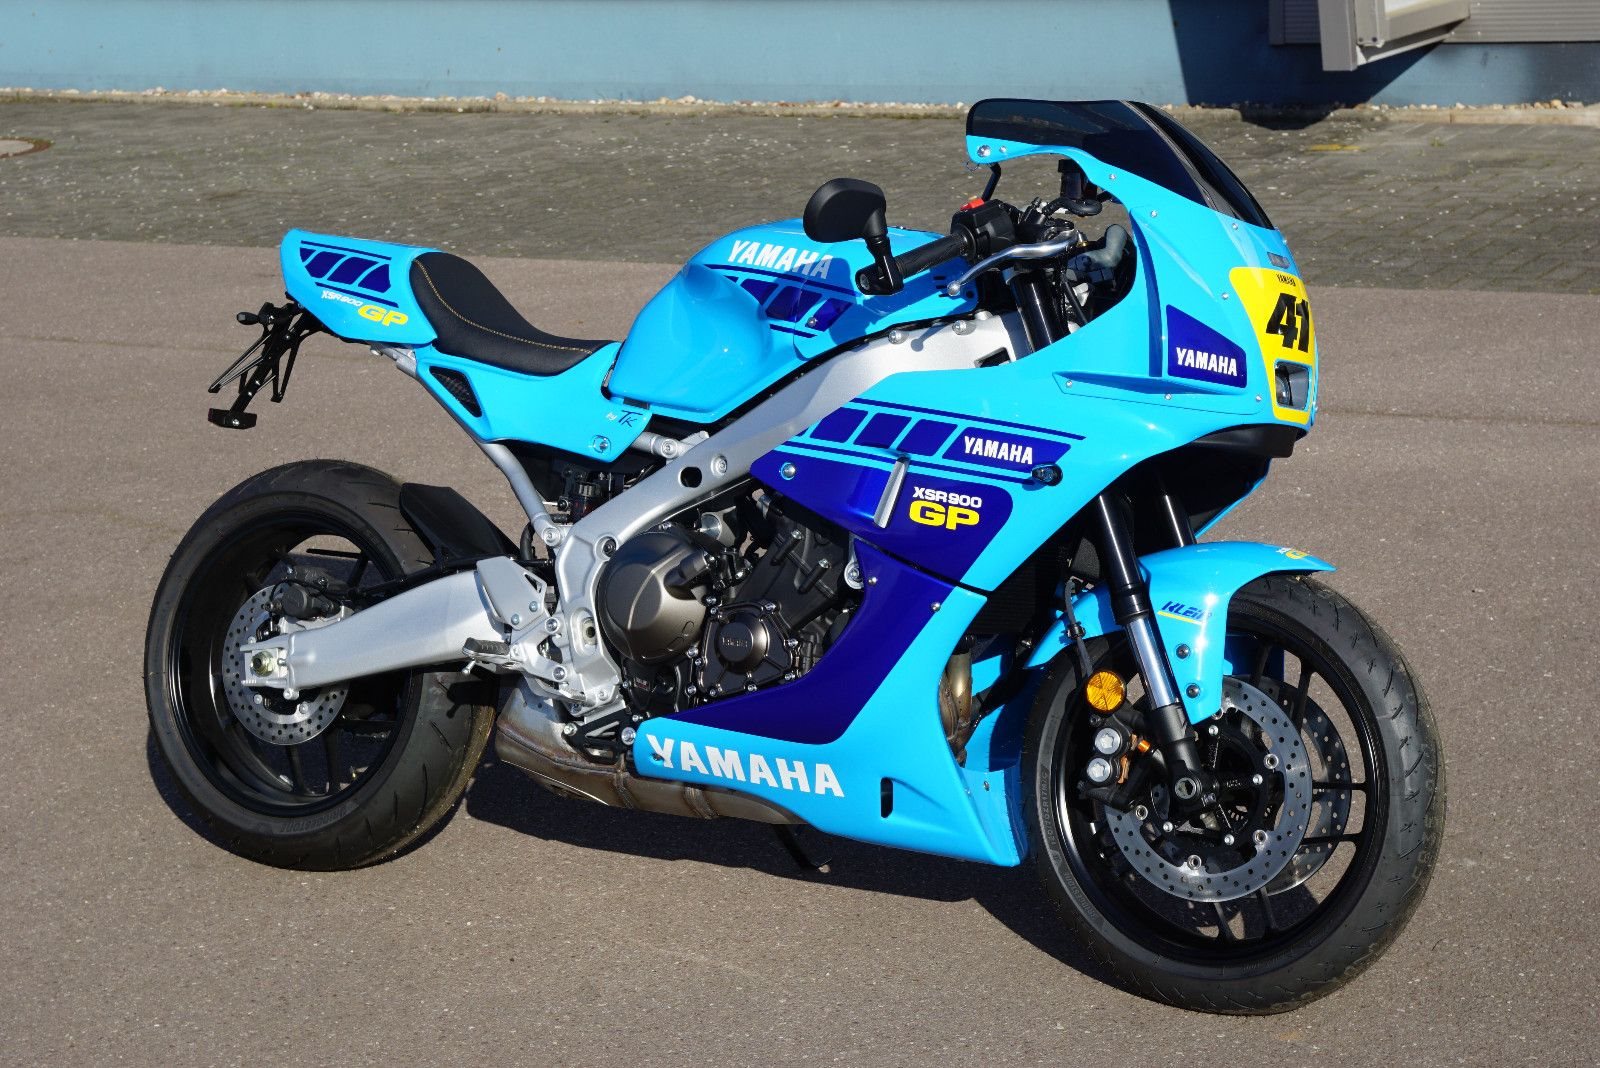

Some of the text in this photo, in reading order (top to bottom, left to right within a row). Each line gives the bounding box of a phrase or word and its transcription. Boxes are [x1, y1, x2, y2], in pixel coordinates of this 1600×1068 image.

[727, 240, 834, 280] YAMAHA
[322, 290, 364, 307] XSR900
[358, 304, 409, 327] GP
[1266, 292, 1310, 353] 41
[1176, 347, 1238, 377] YAMAHA
[964, 436, 1033, 465] YAMAHA
[912, 486, 983, 509] XSR900
[909, 499, 980, 530] GP
[646, 733, 845, 798] YAMAHA
